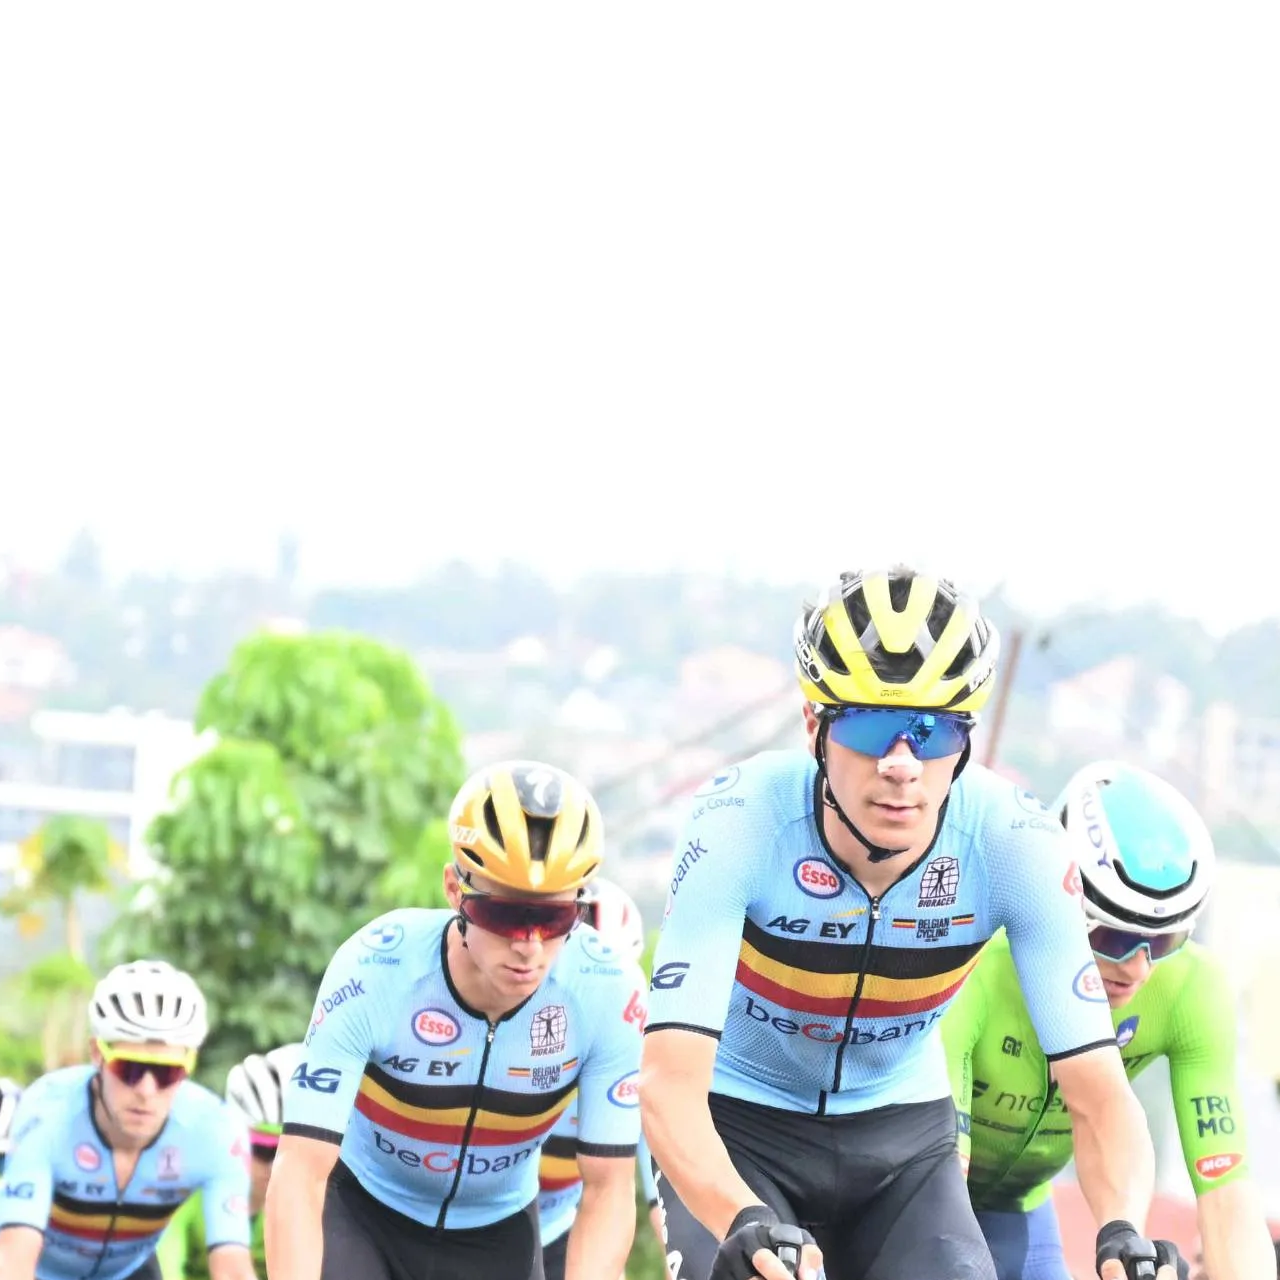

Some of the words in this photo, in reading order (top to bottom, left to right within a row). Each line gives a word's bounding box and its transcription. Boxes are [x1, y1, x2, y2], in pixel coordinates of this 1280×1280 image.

[765, 914, 811, 935] AG
[820, 921, 857, 939] EY
[915, 927, 950, 940] CYCLING
[916, 917, 950, 930] BELGIAN
[650, 961, 691, 992] G
[381, 1054, 420, 1073] AG
[426, 1059, 462, 1077] EY
[532, 1065, 561, 1077] BELGIAN
[290, 1061, 342, 1094] AG
[1190, 1095, 1232, 1114] TRI
[1197, 1116, 1236, 1138] MO
[1200, 1156, 1233, 1175] MOL
